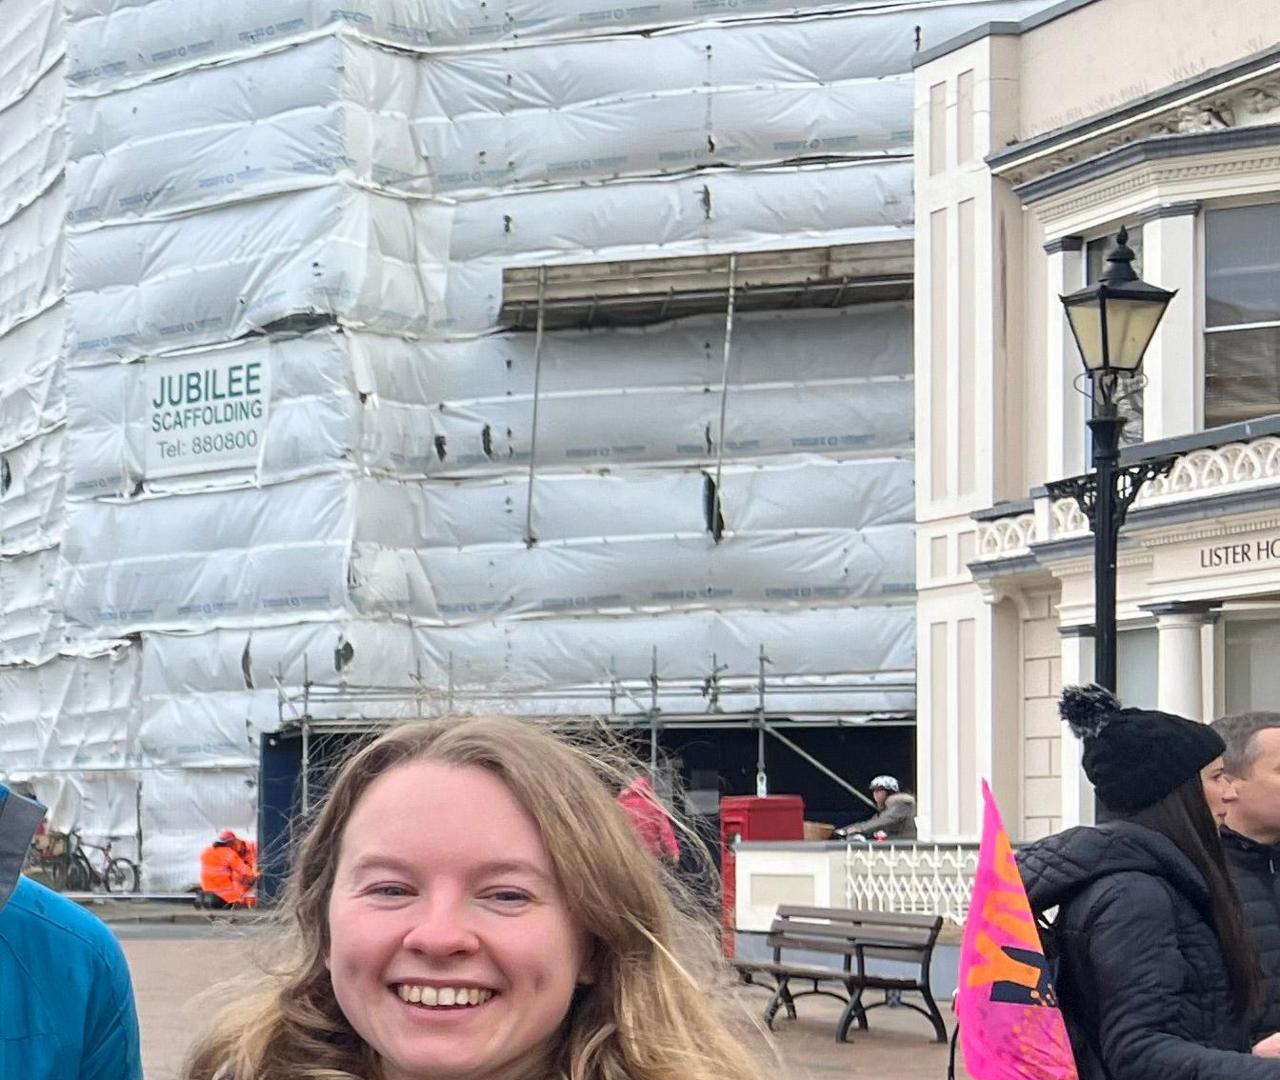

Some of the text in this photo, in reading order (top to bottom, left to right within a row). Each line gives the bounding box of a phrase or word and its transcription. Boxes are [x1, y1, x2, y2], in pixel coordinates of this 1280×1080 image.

[151, 362, 263, 409] JUBILEE
[151, 400, 264, 433] SCAFFOLDING
[156, 428, 258, 459] Tel: 880800
[1200, 543, 1252, 569] LISTER
